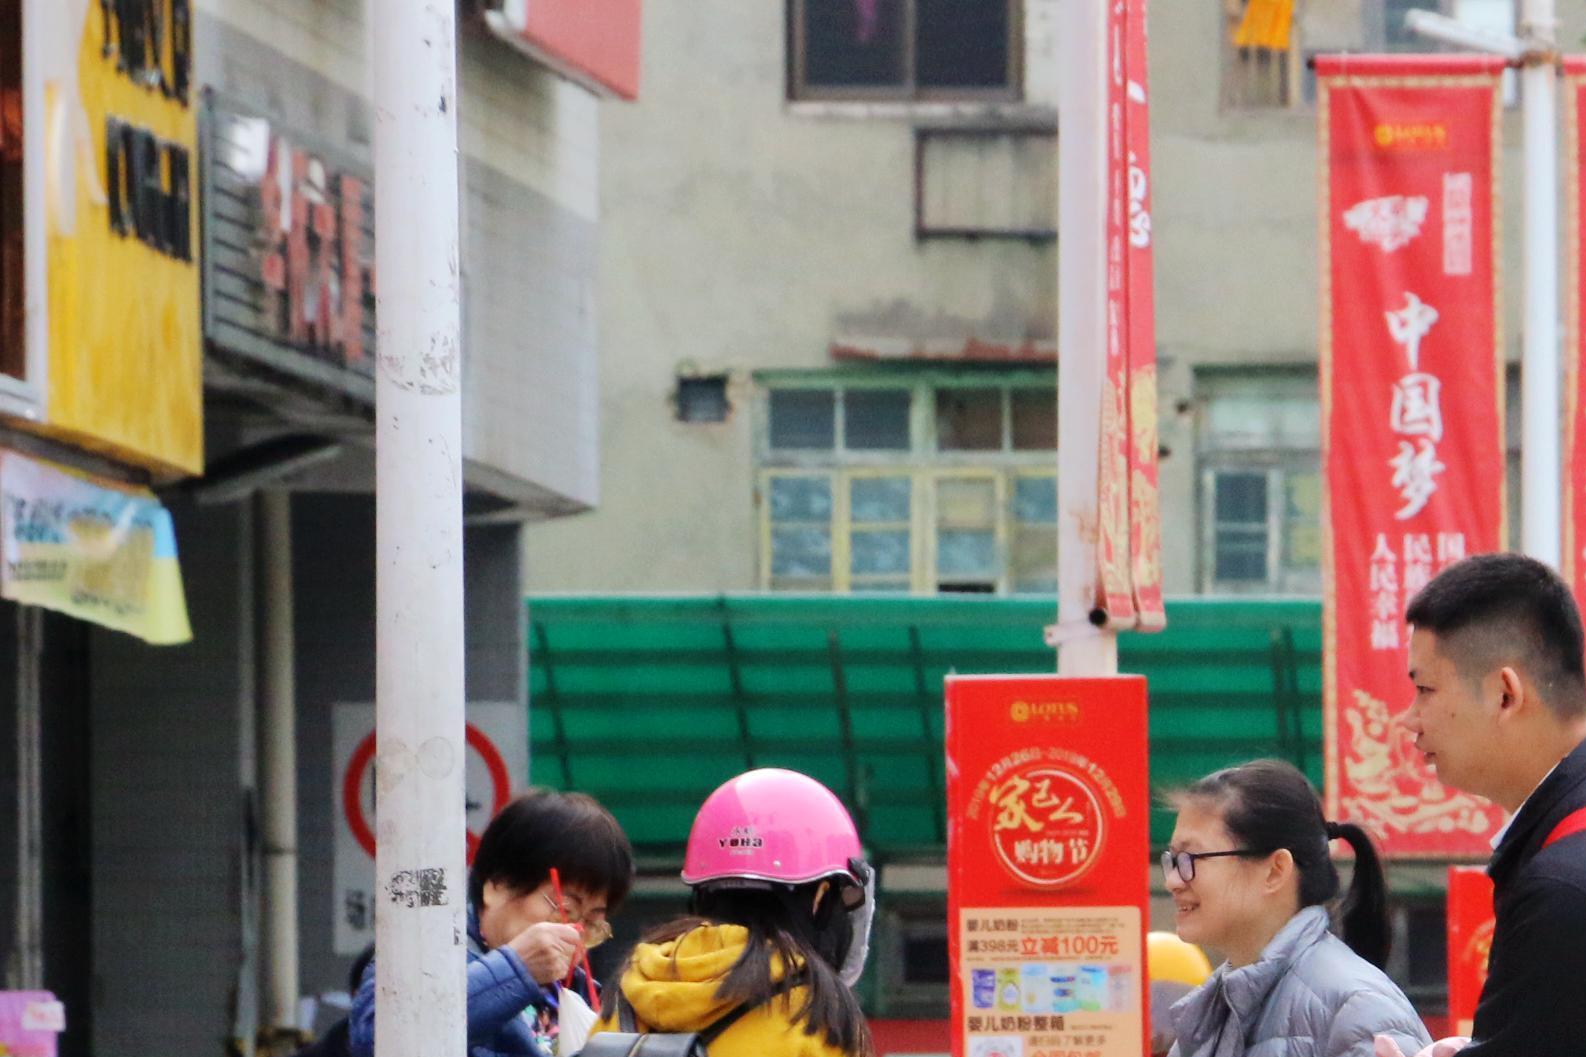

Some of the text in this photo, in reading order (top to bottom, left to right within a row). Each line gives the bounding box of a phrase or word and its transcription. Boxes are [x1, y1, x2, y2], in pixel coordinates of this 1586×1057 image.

[1383, 291, 1444, 520] 中国梦
[968, 1016, 1065, 1032] 婴儿奶粉整箱
